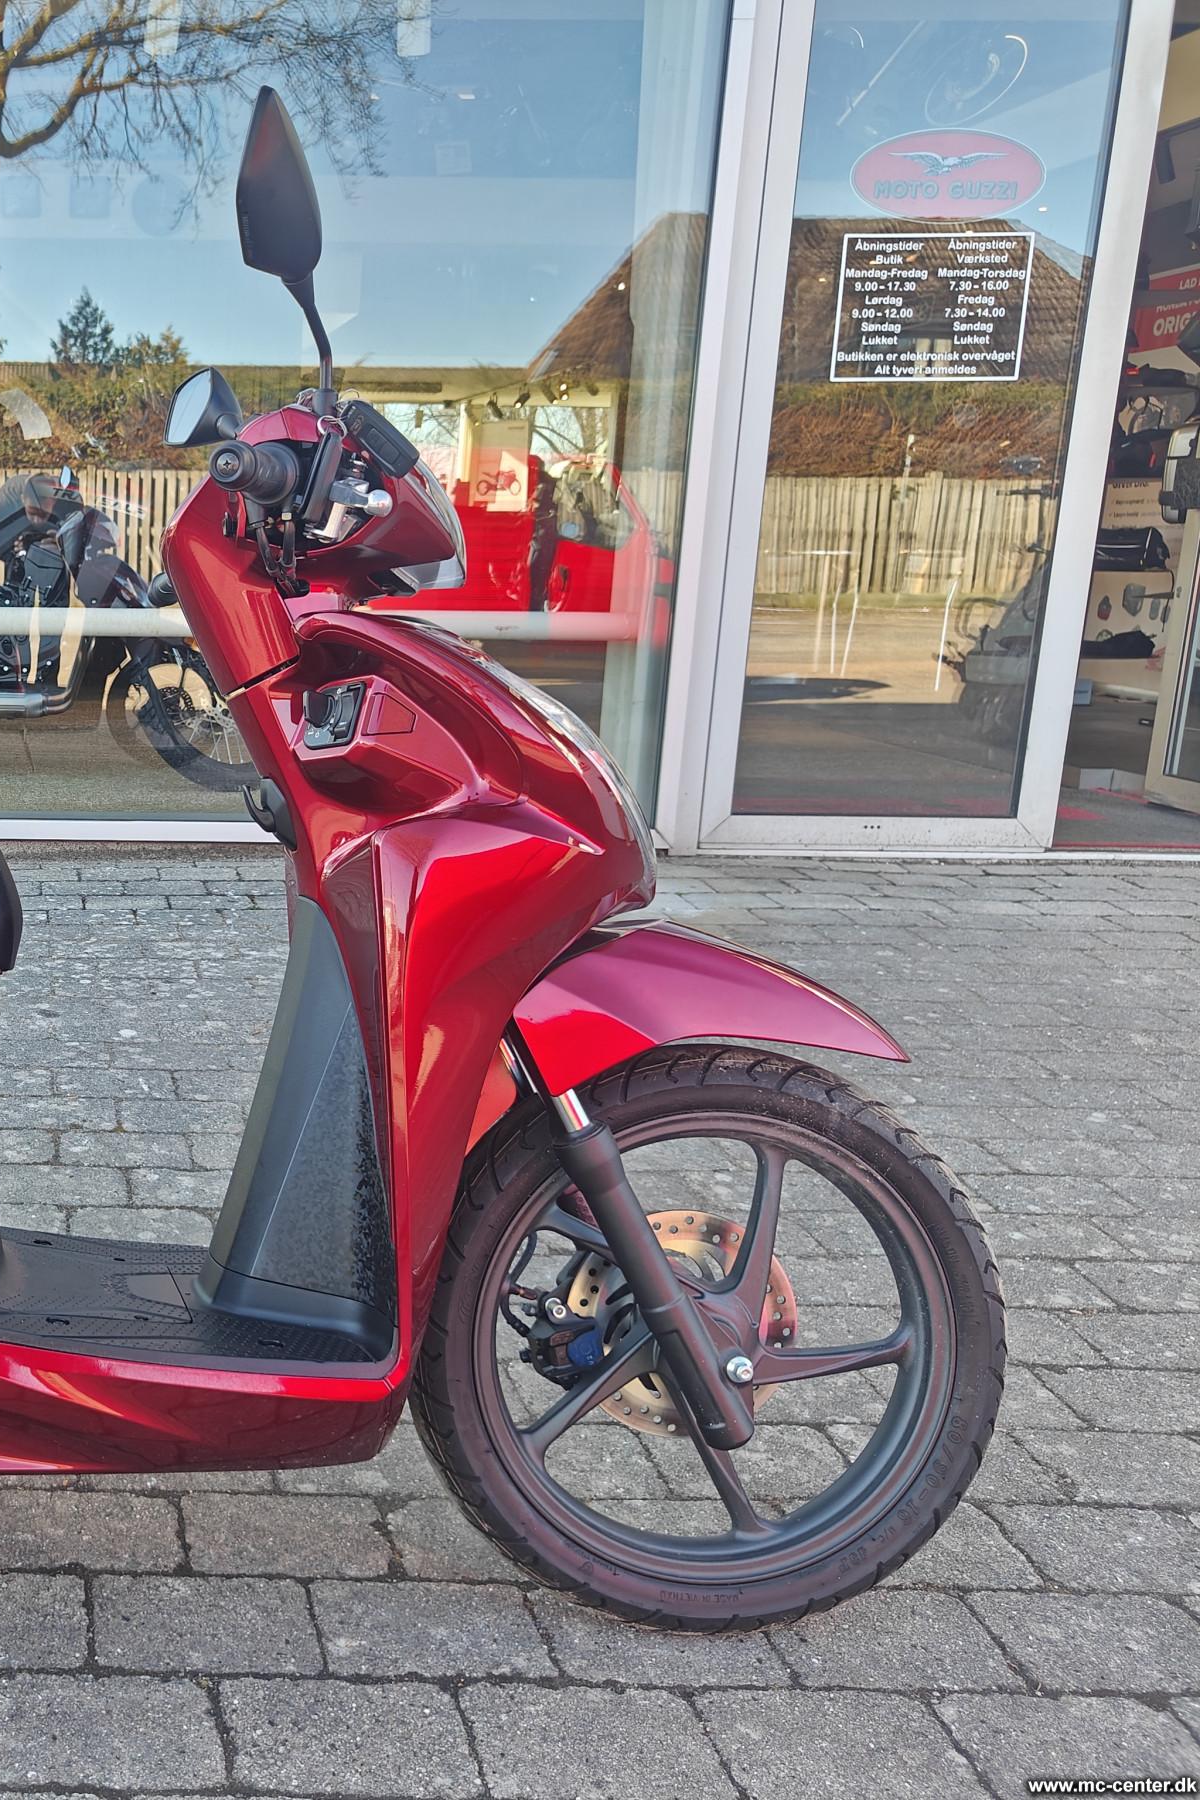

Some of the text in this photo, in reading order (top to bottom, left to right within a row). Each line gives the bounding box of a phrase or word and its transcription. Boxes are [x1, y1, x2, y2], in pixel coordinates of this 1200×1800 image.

[873, 180, 1019, 199] MOTO GUZZI
[854, 238, 925, 253] Åbningstider
[947, 237, 1017, 252] Åbningstider
[875, 254, 904, 265] Butik
[956, 252, 1009, 263] Værksted
[845, 267, 929, 280] Mandag-Fredag
[937, 267, 1026, 280] Mandag-Torsdag
[865, 294, 903, 307] Lørdag
[957, 294, 995, 306] Fredag
[860, 321, 901, 334] Søndag
[952, 320, 994, 333] Søndag
[1152, 311, 1196, 337] ORIG
[862, 335, 898, 345] Lukket
[953, 334, 990, 345] Lukket
[837, 349, 1016, 363] Butikken er elektronisk overvåget
[874, 364, 977, 377] Alt tyveri anmeldes
